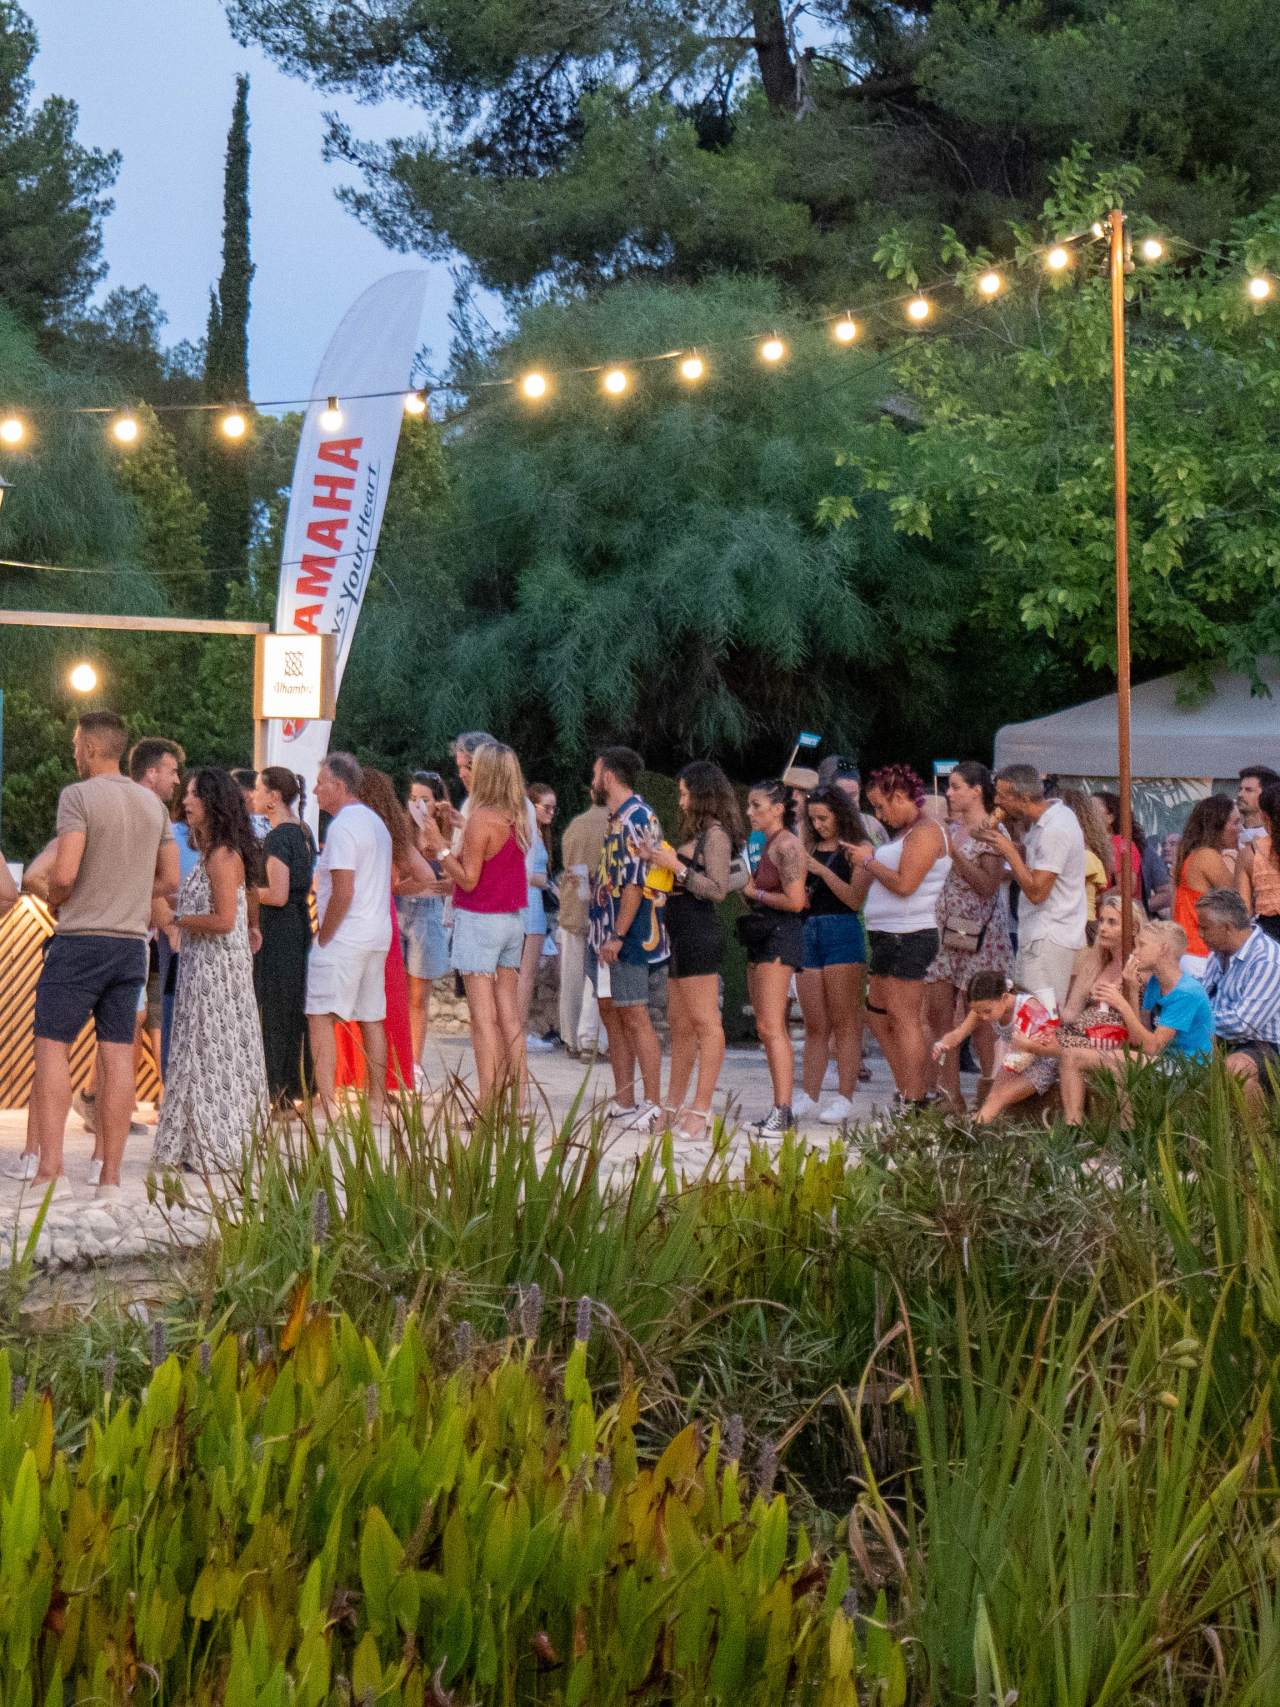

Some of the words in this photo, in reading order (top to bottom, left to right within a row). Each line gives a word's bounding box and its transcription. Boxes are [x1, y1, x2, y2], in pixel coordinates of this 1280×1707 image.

[293, 437, 363, 634] AMAHA
[330, 603, 345, 634] vs
[340, 537, 366, 606] Your
[356, 462, 377, 538] Heart
